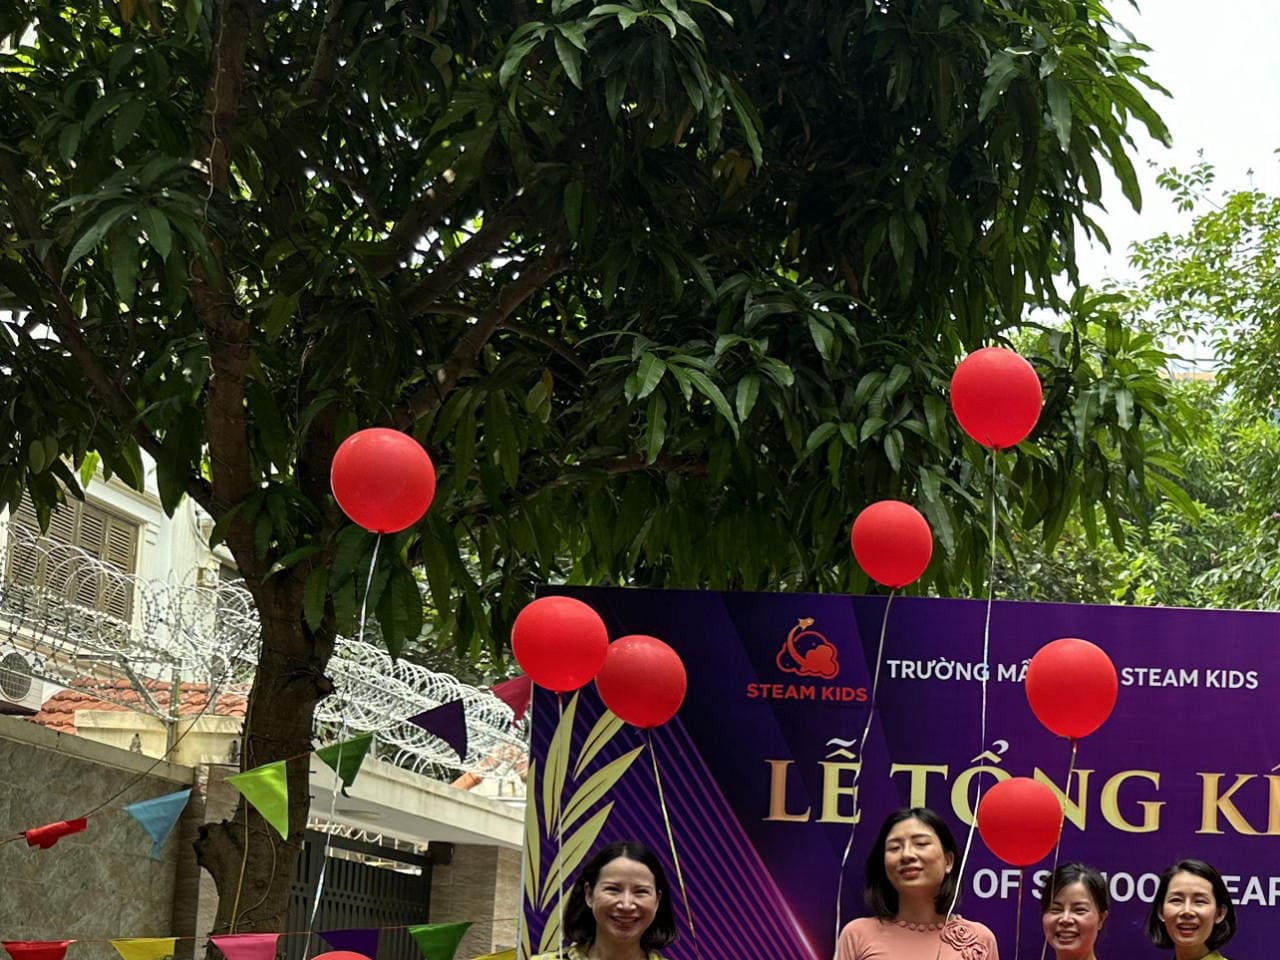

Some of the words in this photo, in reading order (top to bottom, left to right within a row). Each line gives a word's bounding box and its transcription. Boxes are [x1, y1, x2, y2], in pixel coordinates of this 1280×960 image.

[887, 657, 990, 682] TRƯỜNG
[1121, 667, 1199, 688] STEAM
[1206, 669, 1259, 690] KIDS
[746, 683, 817, 700] STEAM
[822, 686, 869, 702] KIDS
[762, 737, 863, 825] LỄ
[973, 868, 1022, 899] OF
[1032, 870, 1160, 903] SOO
